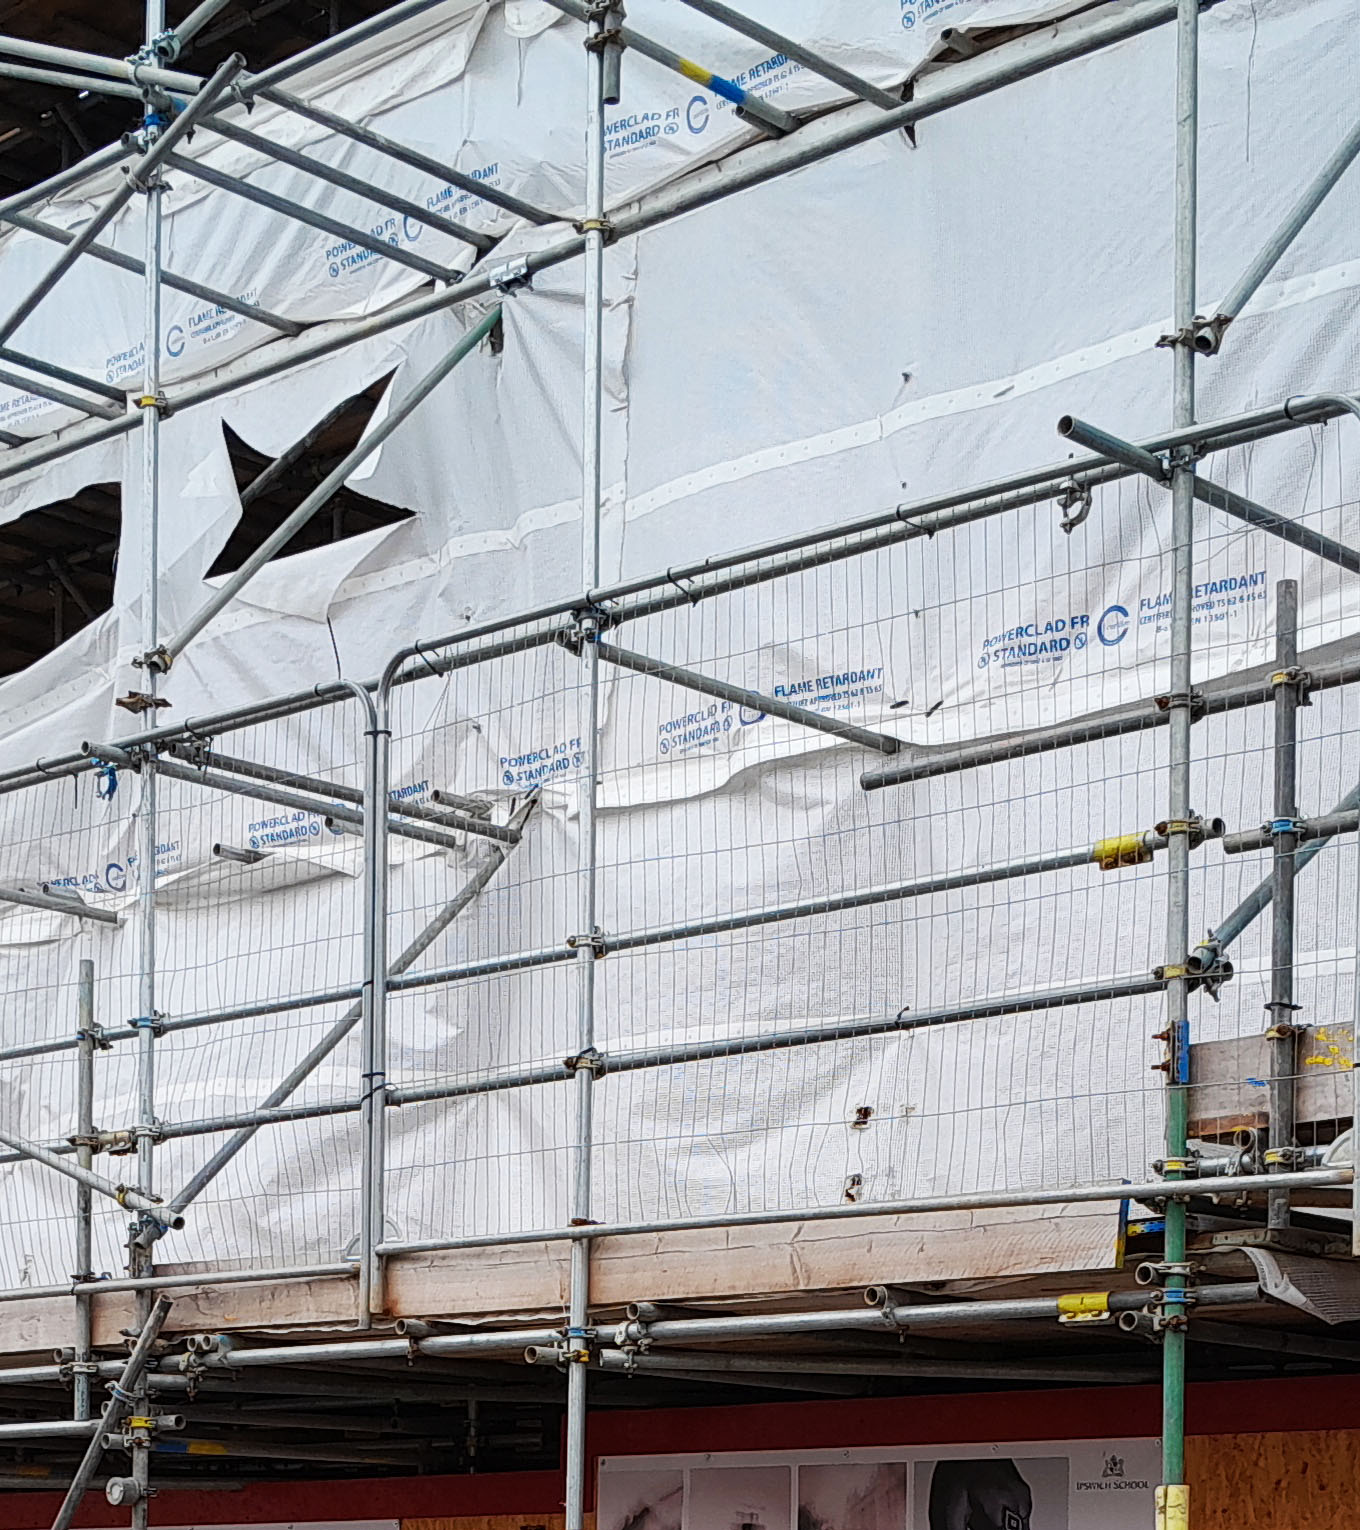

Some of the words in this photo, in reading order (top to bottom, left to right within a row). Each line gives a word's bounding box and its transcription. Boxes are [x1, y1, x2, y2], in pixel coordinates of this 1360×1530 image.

[749, 52, 791, 81] RETARD
[603, 112, 661, 137] WERCLAD
[340, 247, 380, 271] STAND
[1140, 590, 1173, 611] FLAM
[1192, 571, 1267, 599] ETARDANT
[982, 618, 1067, 651] POWERCLAD
[1070, 614, 1090, 630] FR
[992, 637, 1071, 662] STANDARD
[774, 680, 815, 698] FLAME
[815, 667, 884, 692] RETARDANT
[671, 720, 720, 749] STANDARD
[499, 742, 568, 769] POWERCLAD
[516, 757, 570, 782] STANDARD
[248, 811, 306, 833] POWERCLAD
[260, 826, 308, 846] STANDARD
[1112, 1480, 1150, 1491] SCHOOL
